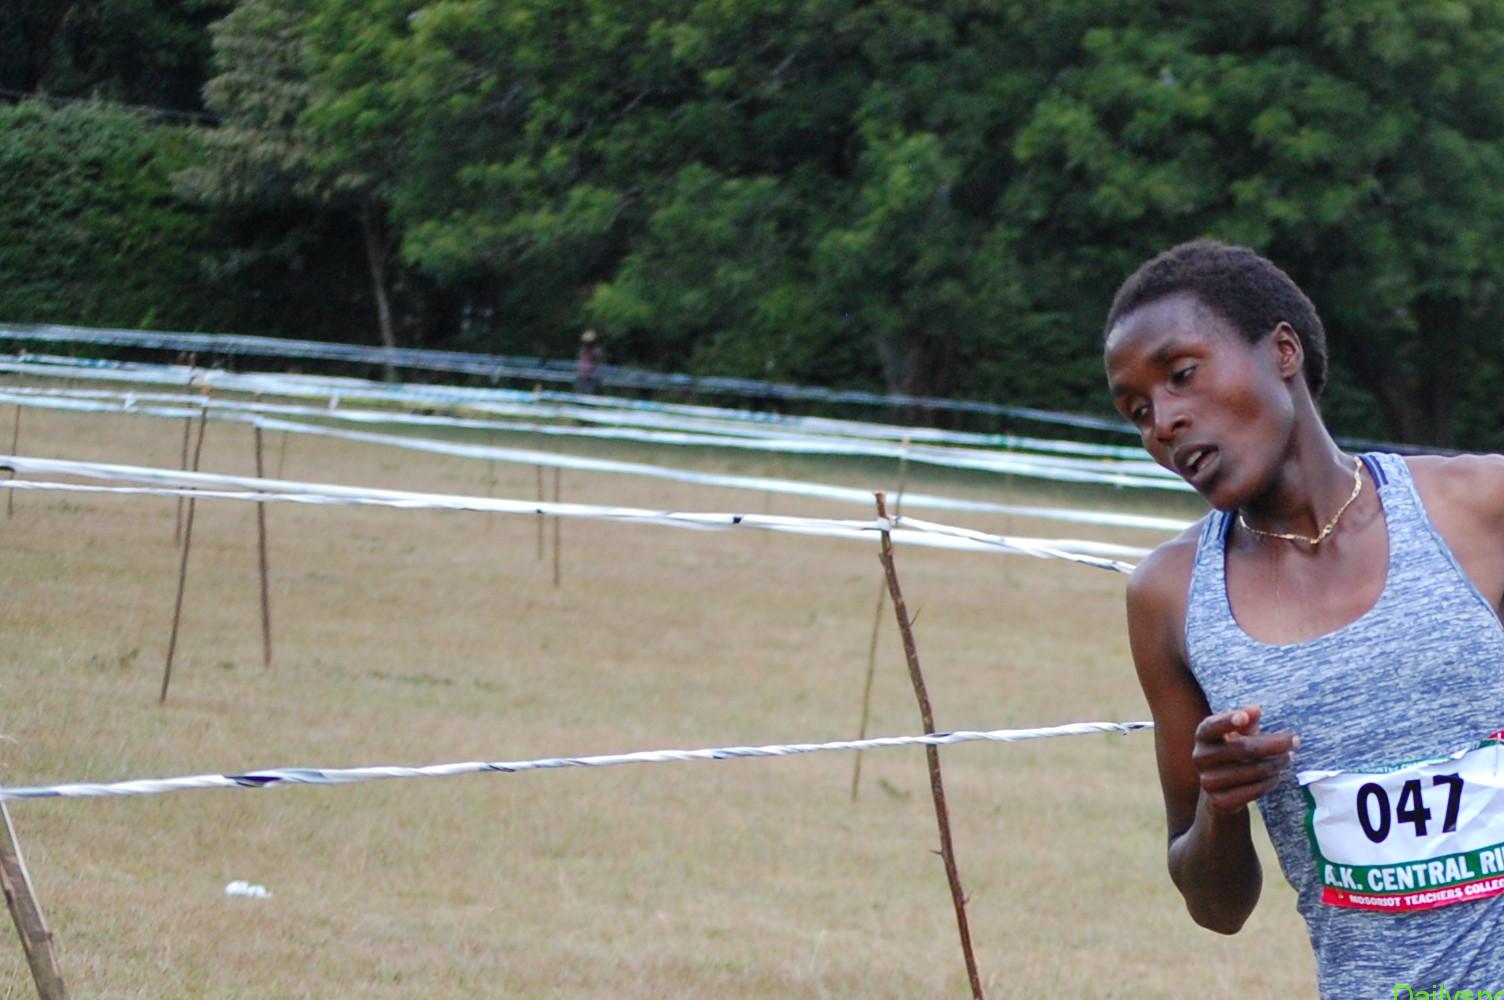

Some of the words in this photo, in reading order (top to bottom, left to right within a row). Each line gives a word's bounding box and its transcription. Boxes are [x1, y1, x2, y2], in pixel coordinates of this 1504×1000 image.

[1356, 772, 1464, 843] 047
[1324, 864, 1363, 890] A.K.
[1367, 856, 1475, 892] CENTRAL
[1404, 889, 1463, 905] TEACHERS
